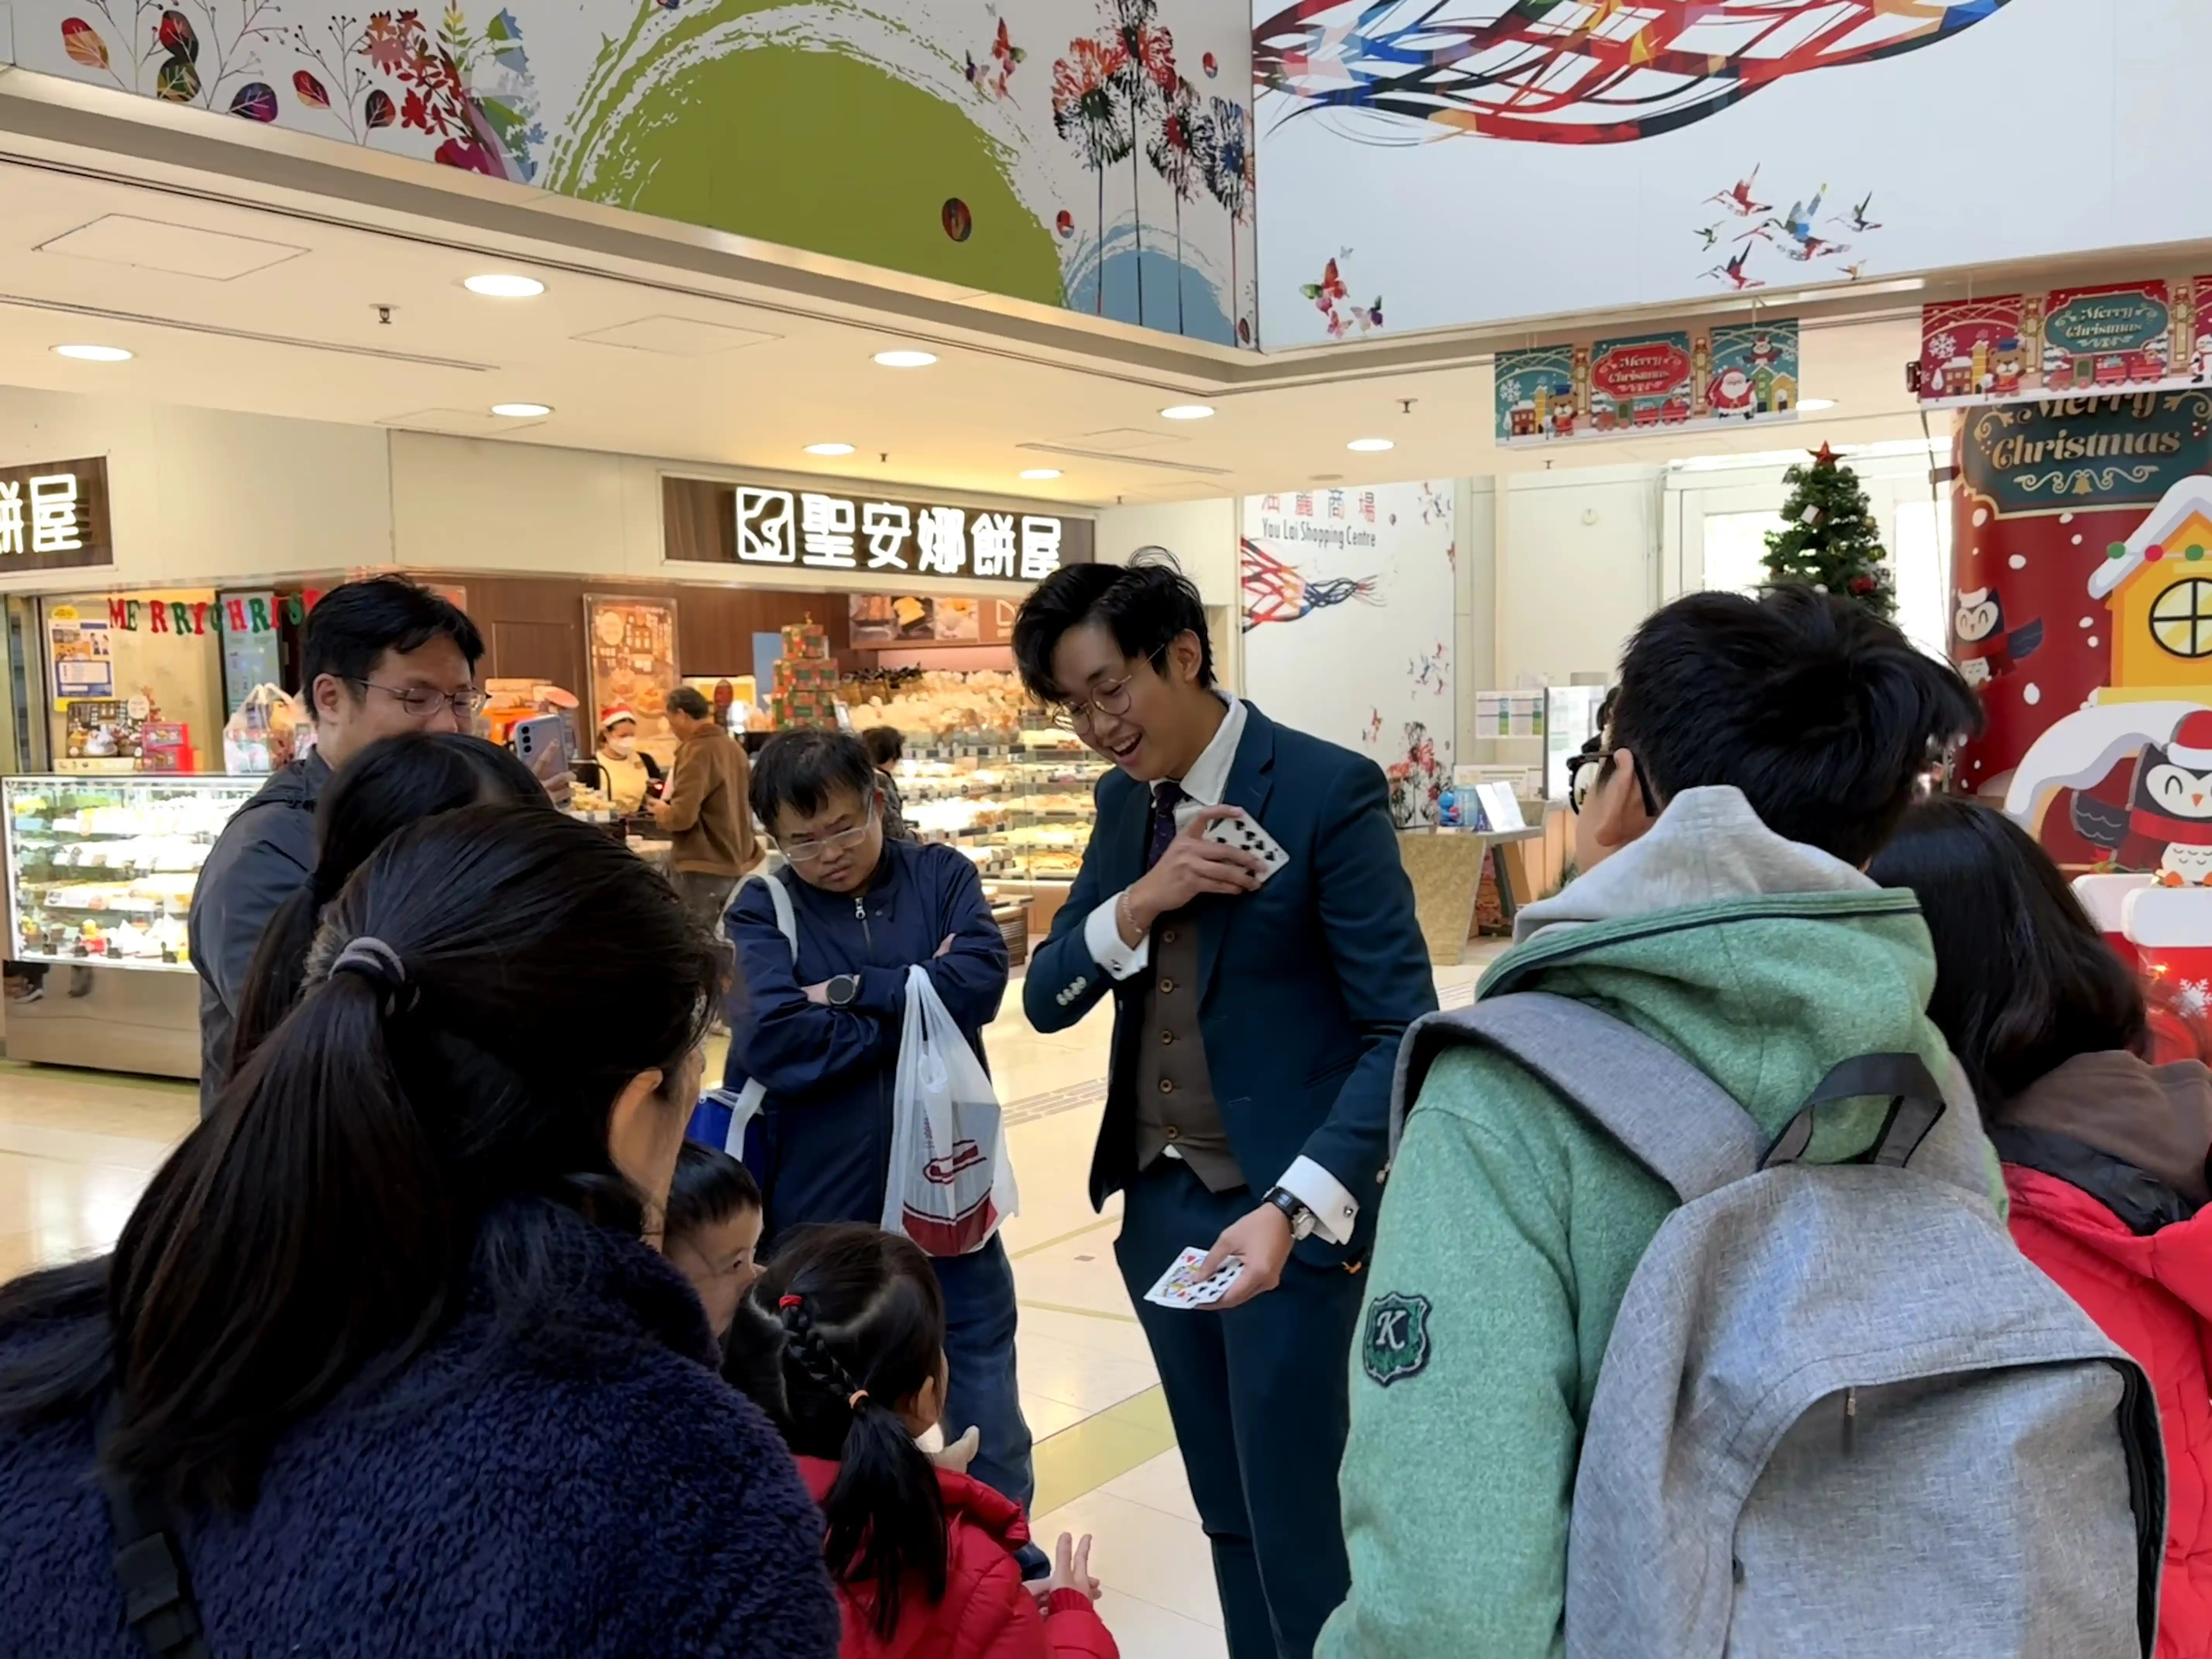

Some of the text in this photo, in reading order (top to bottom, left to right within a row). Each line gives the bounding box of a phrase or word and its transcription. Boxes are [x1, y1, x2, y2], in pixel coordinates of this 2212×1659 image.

[2081, 306, 2133, 320] Merry
[2065, 322, 2142, 338] Christmas
[1608, 370, 1670, 383] Christmas
[1620, 355, 1662, 368] Merry
[1992, 429, 2181, 470] Christmas
[800, 493, 1061, 579] 聖安娜餅屋
[1300, 520, 1344, 550] Shopping
[1346, 525, 1376, 547] Centre
[108, 597, 208, 635] MERRY
[1375, 1310, 1408, 1350] K
